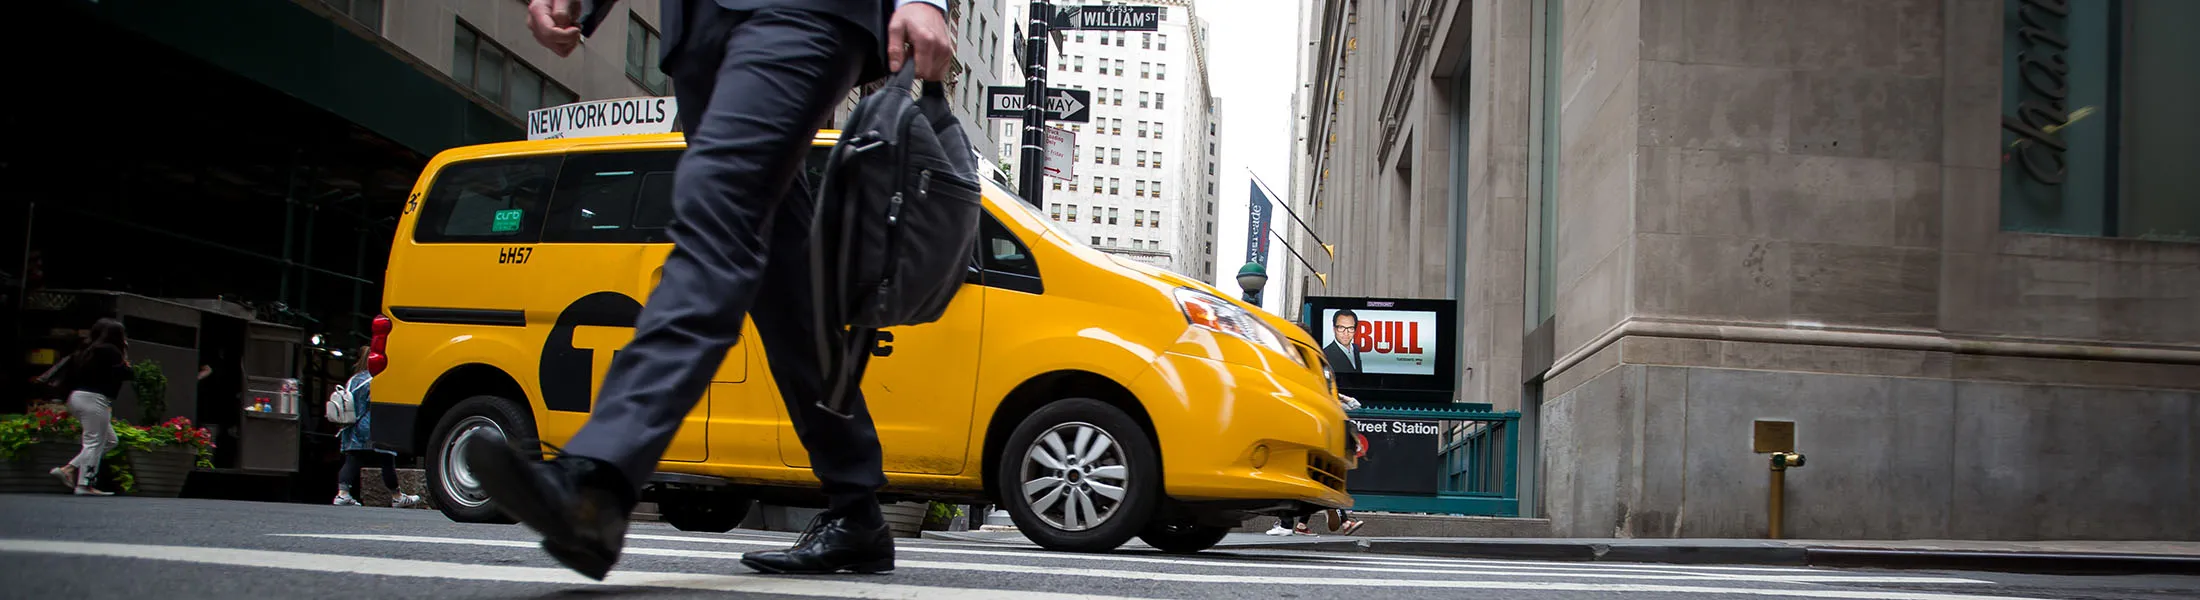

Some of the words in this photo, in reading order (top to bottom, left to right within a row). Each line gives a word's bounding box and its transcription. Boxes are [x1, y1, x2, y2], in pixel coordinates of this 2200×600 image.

[1084, 11, 1145, 27] WILLIAM
[1145, 13, 1156, 22] ST
[1001, 96, 1026, 108] ON
[1045, 98, 1074, 112] WAY
[530, 108, 563, 136] NEW
[566, 103, 608, 131] YORK
[611, 99, 666, 126] DOLLS
[496, 210, 520, 221] curb
[1353, 319, 1424, 355] BULL
[1349, 419, 1388, 433] treet
[1391, 421, 1439, 435] Station
